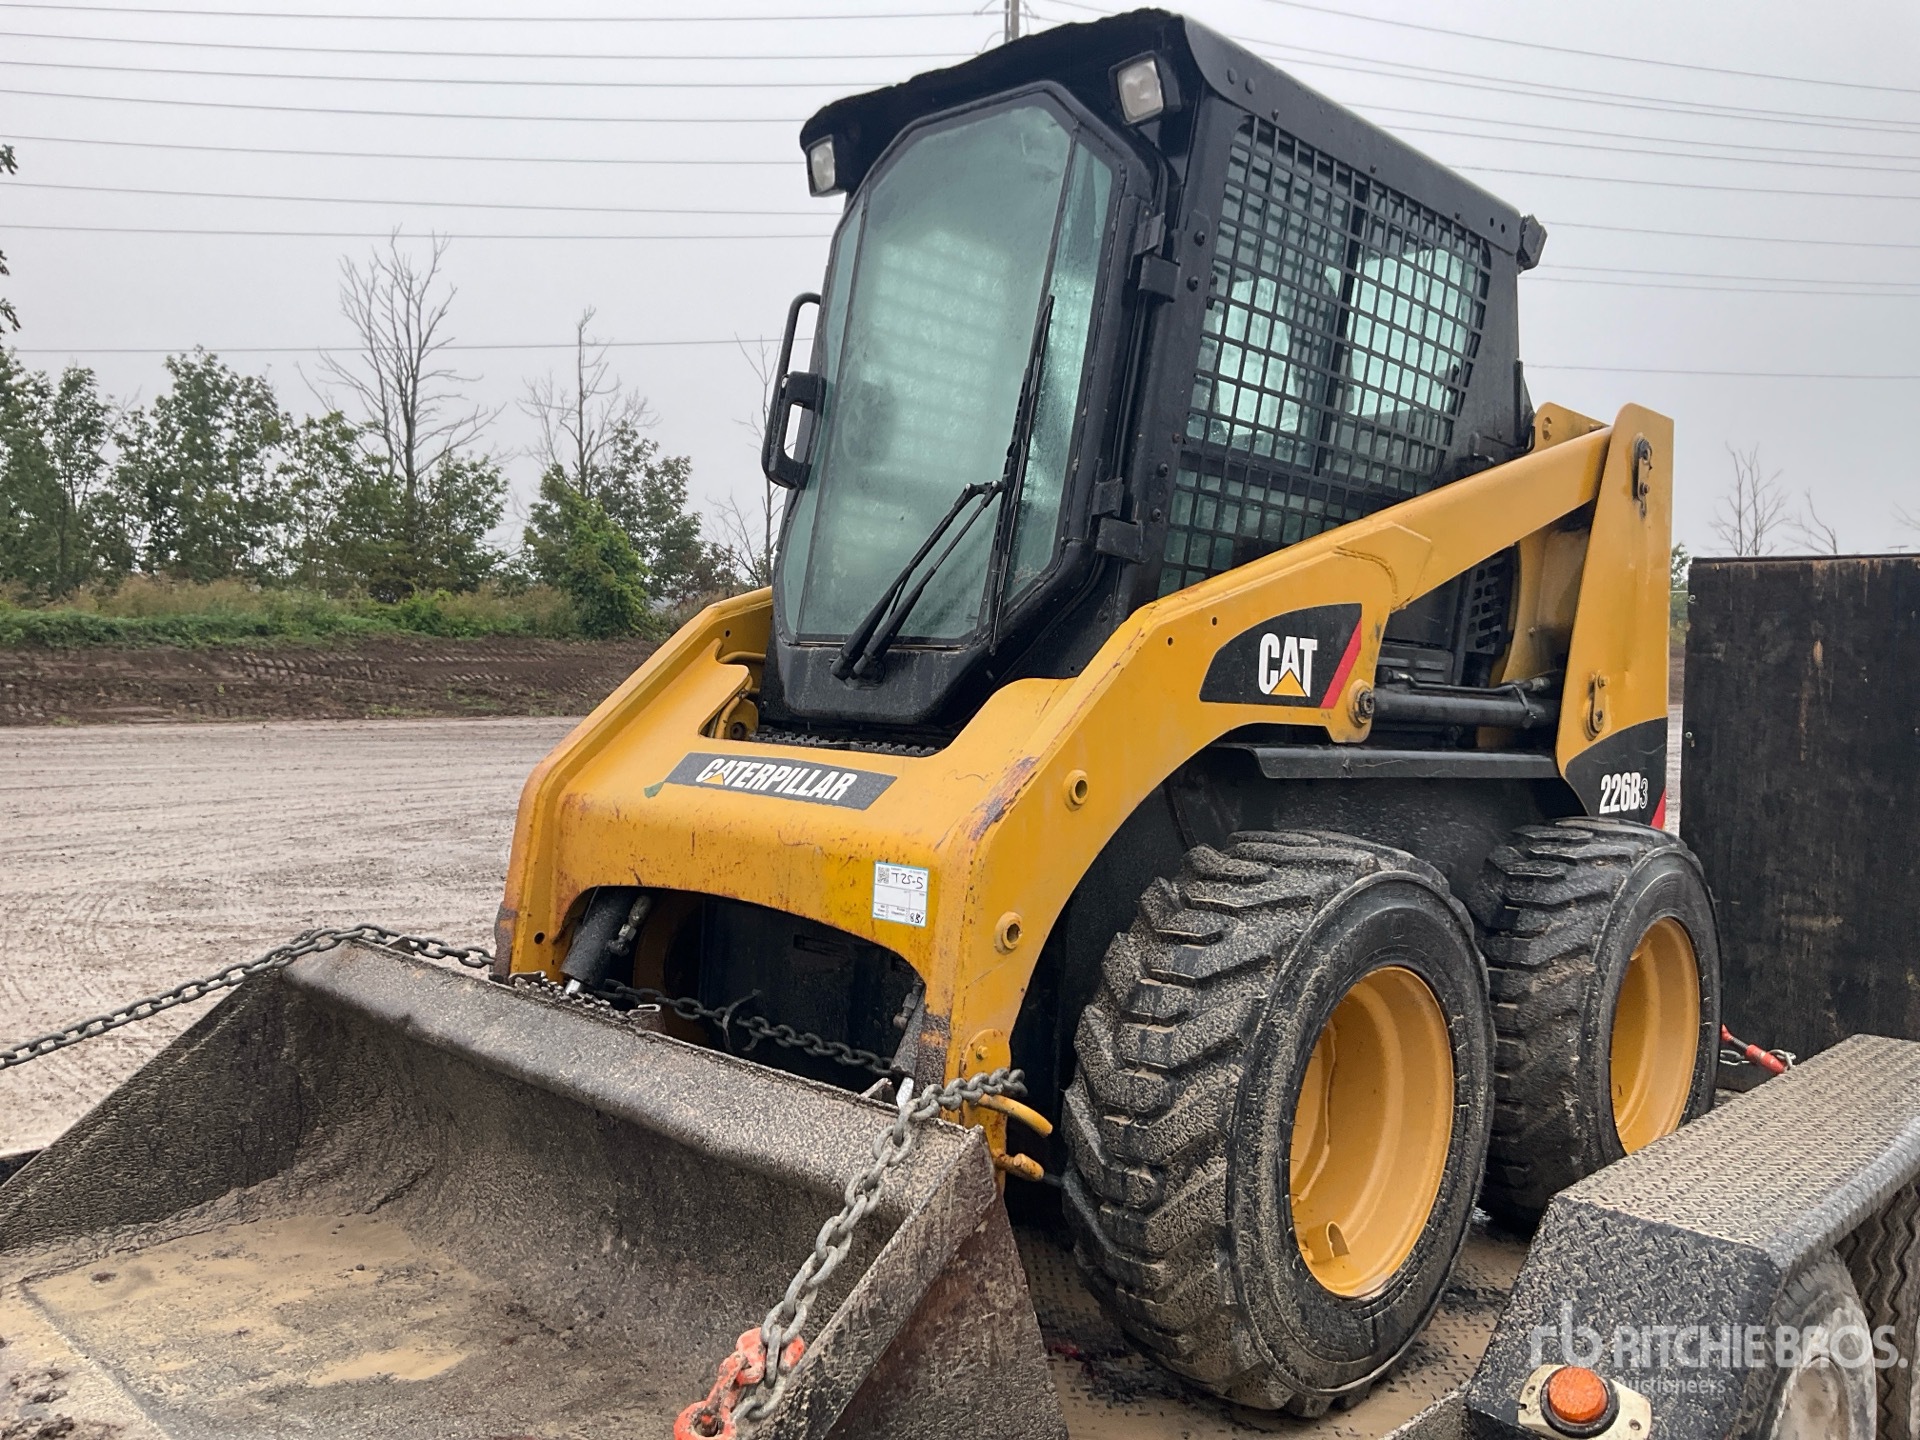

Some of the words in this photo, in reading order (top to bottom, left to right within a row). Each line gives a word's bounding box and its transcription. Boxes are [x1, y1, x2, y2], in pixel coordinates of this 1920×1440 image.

[1258, 633, 1318, 698] CAT
[695, 758, 857, 801] CATERPILLAR
[1599, 772, 1649, 815] 226B3
